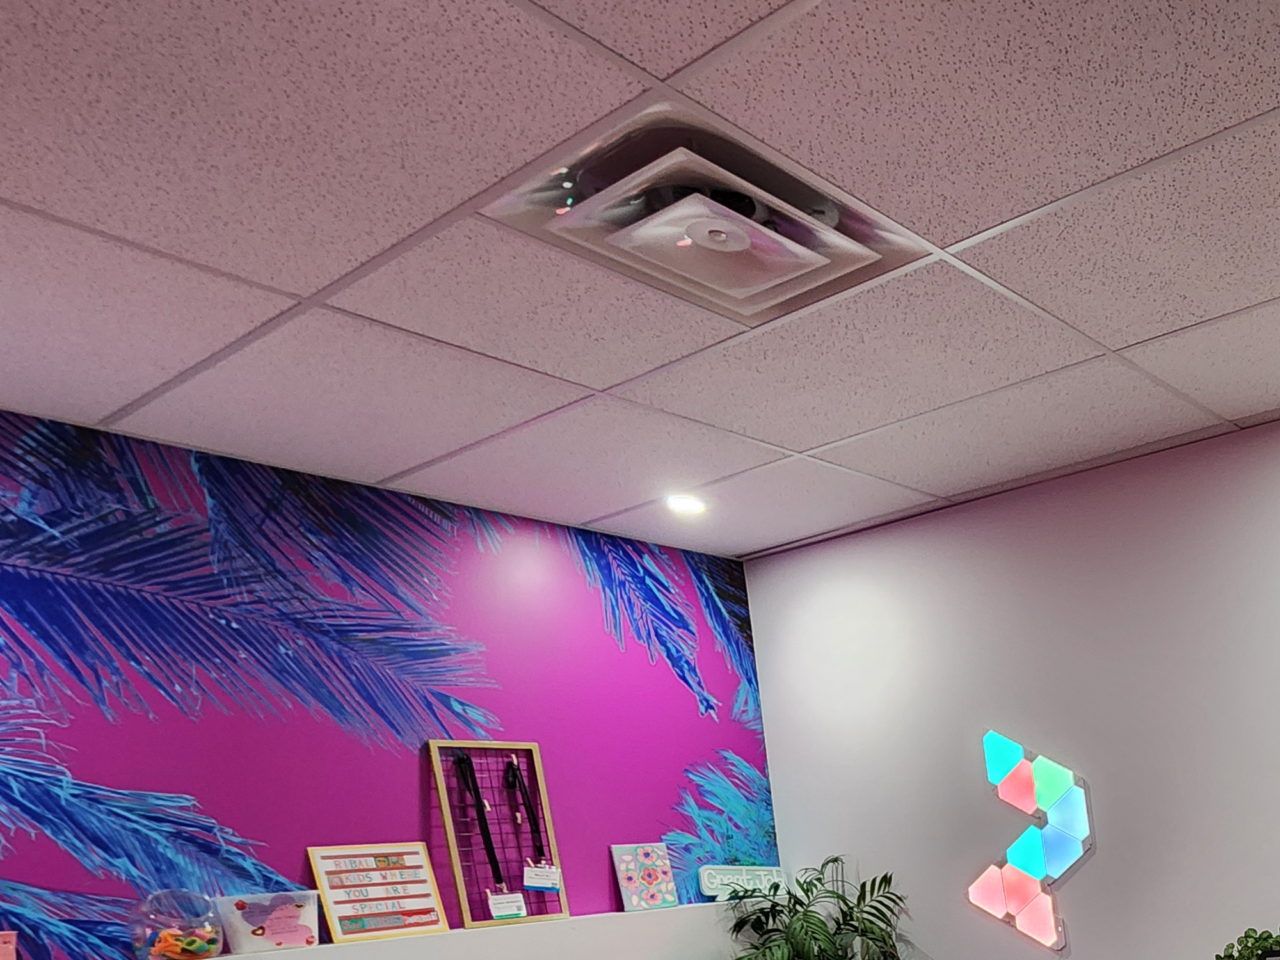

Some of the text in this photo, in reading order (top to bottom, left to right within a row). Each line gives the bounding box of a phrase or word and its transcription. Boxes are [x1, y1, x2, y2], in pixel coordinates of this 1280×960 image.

[344, 869, 420, 884] KIDS WHERE
[704, 868, 753, 890] Great
[344, 886, 410, 899] YOU ARE
[352, 900, 406, 914] SPECIAL
